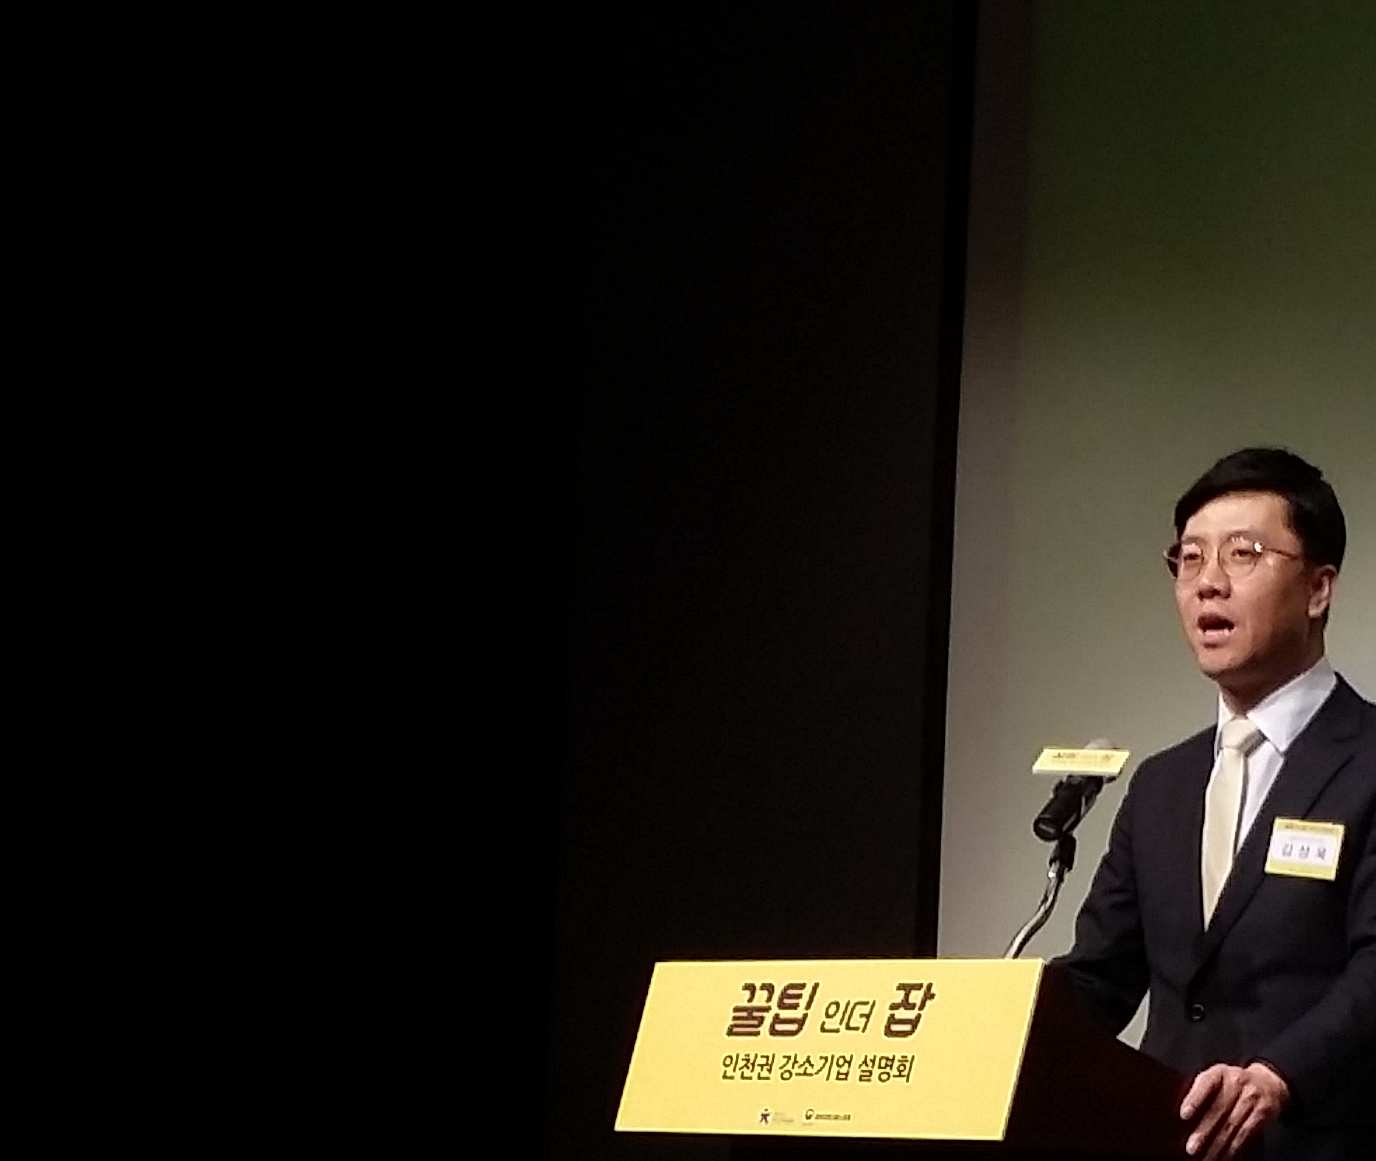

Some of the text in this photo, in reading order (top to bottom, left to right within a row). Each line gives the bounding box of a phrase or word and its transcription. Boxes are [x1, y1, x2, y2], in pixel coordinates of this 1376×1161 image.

[725, 981, 937, 1039] 꿀팁 인더 잡
[721, 1052, 916, 1084] 인천권 강소기업 설명회
